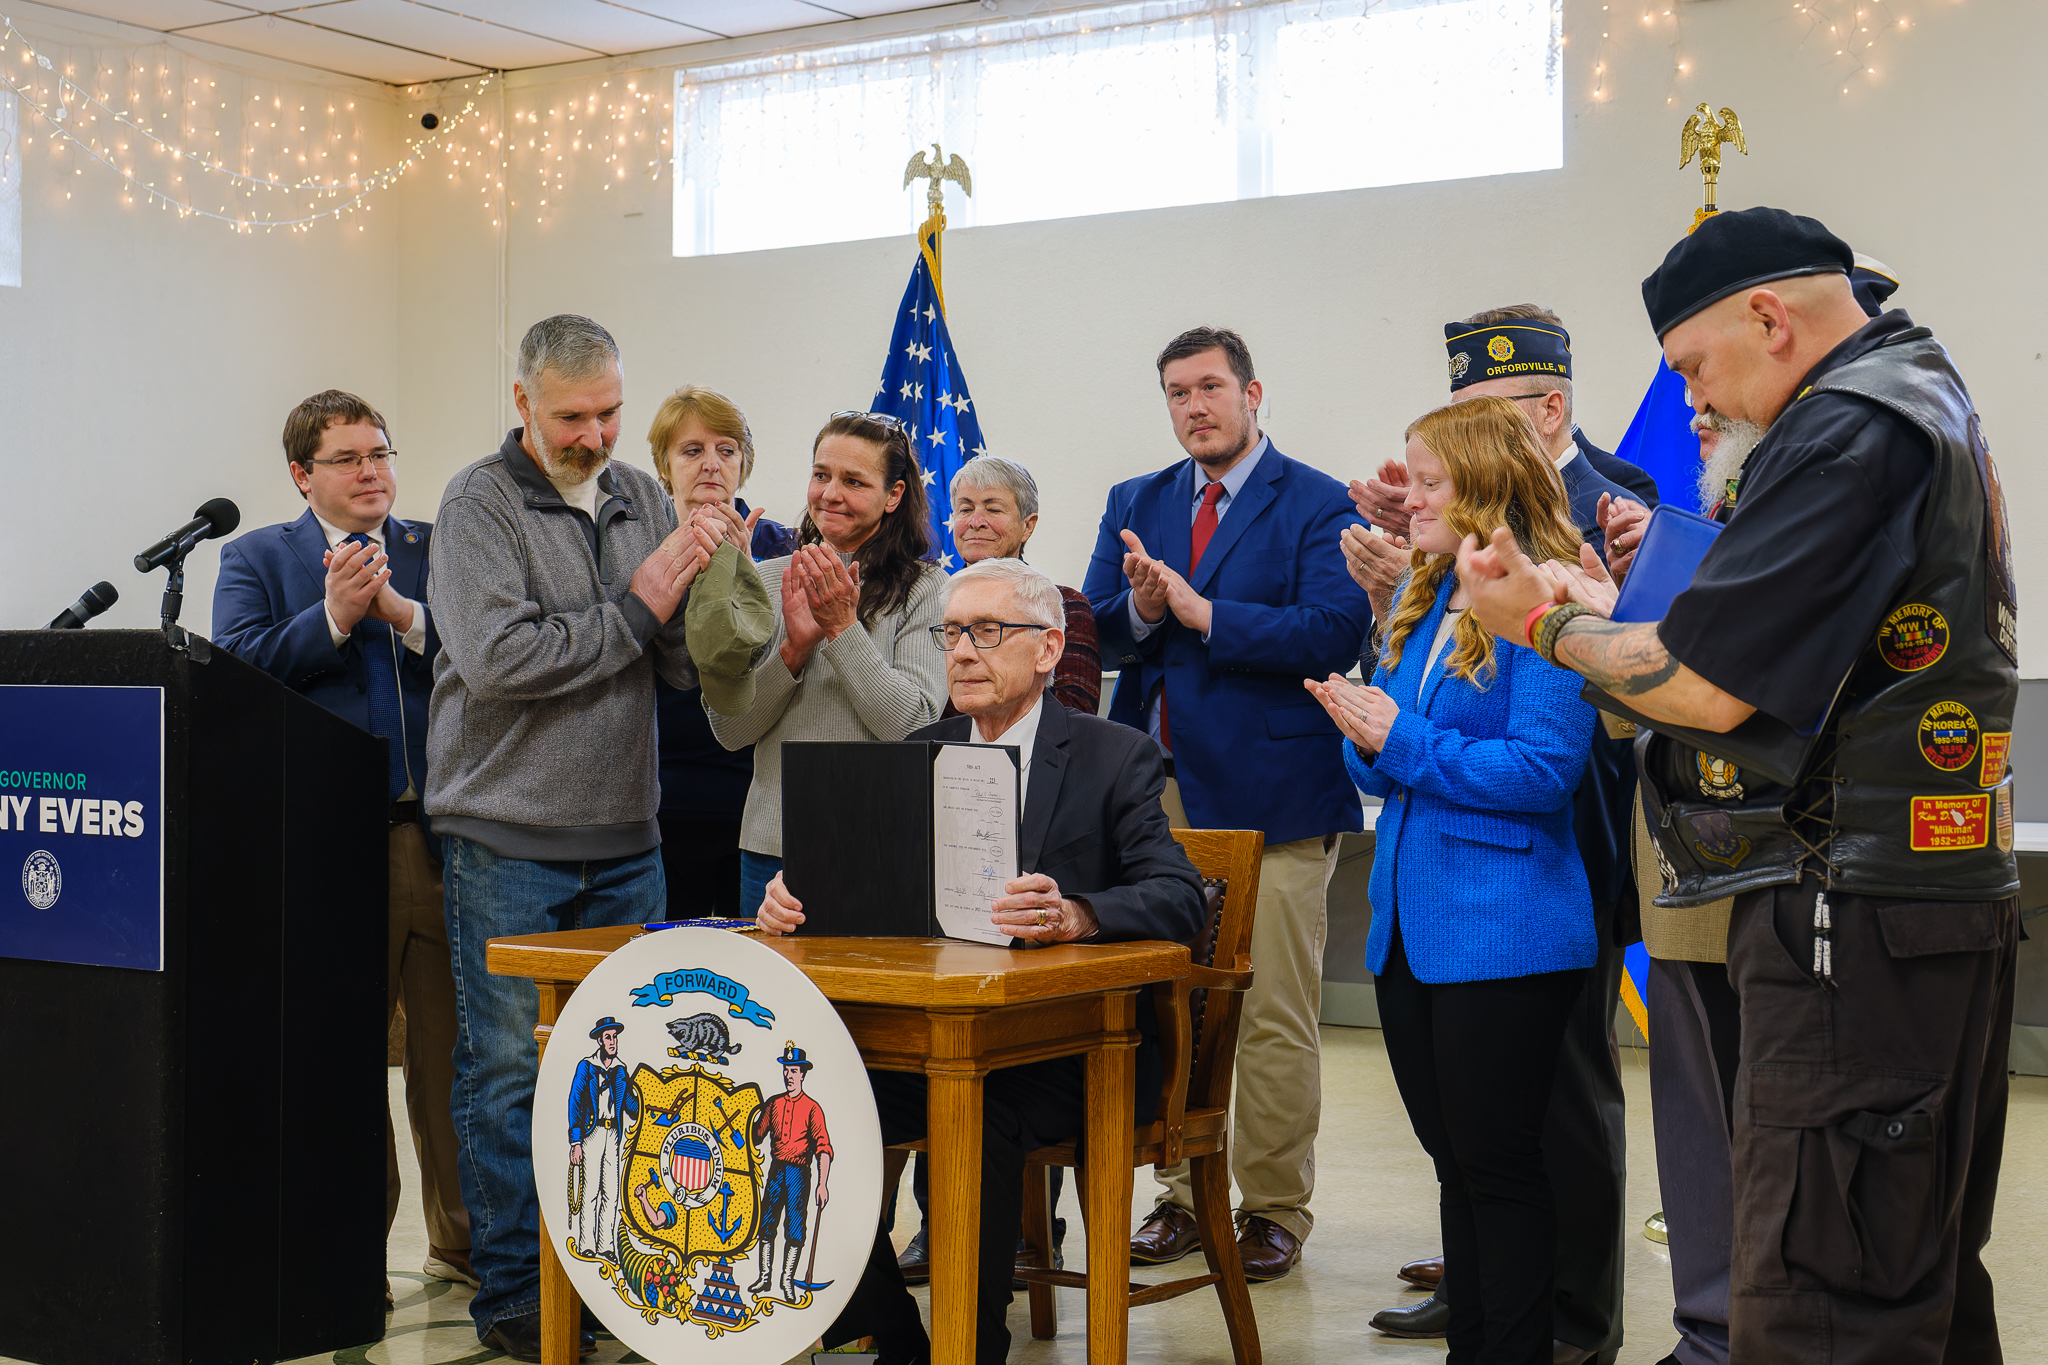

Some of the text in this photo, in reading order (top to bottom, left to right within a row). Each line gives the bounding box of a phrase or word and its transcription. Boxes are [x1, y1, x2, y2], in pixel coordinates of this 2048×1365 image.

[1486, 362, 1566, 376] ORFORDVILLE, WI
[1880, 606, 1946, 637] IN MEMORY OF
[1896, 621, 1920, 634] WW
[1908, 643, 1944, 669] RETURNED
[1921, 704, 1977, 732] IN MEMORY OF
[1933, 720, 1966, 730] KOREA
[1924, 745, 1946, 766] NEVER
[1946, 744, 1975, 768] RETURNED
[0, 770, 86, 790] GOVERNOR
[1922, 799, 1981, 810] In Memory Of
[40, 796, 144, 838] EVERS
[1929, 824, 1976, 834] "Milkman"
[664, 973, 738, 1000] FORWARD
[662, 1126, 722, 1190] E PLURIBUS UNUM
